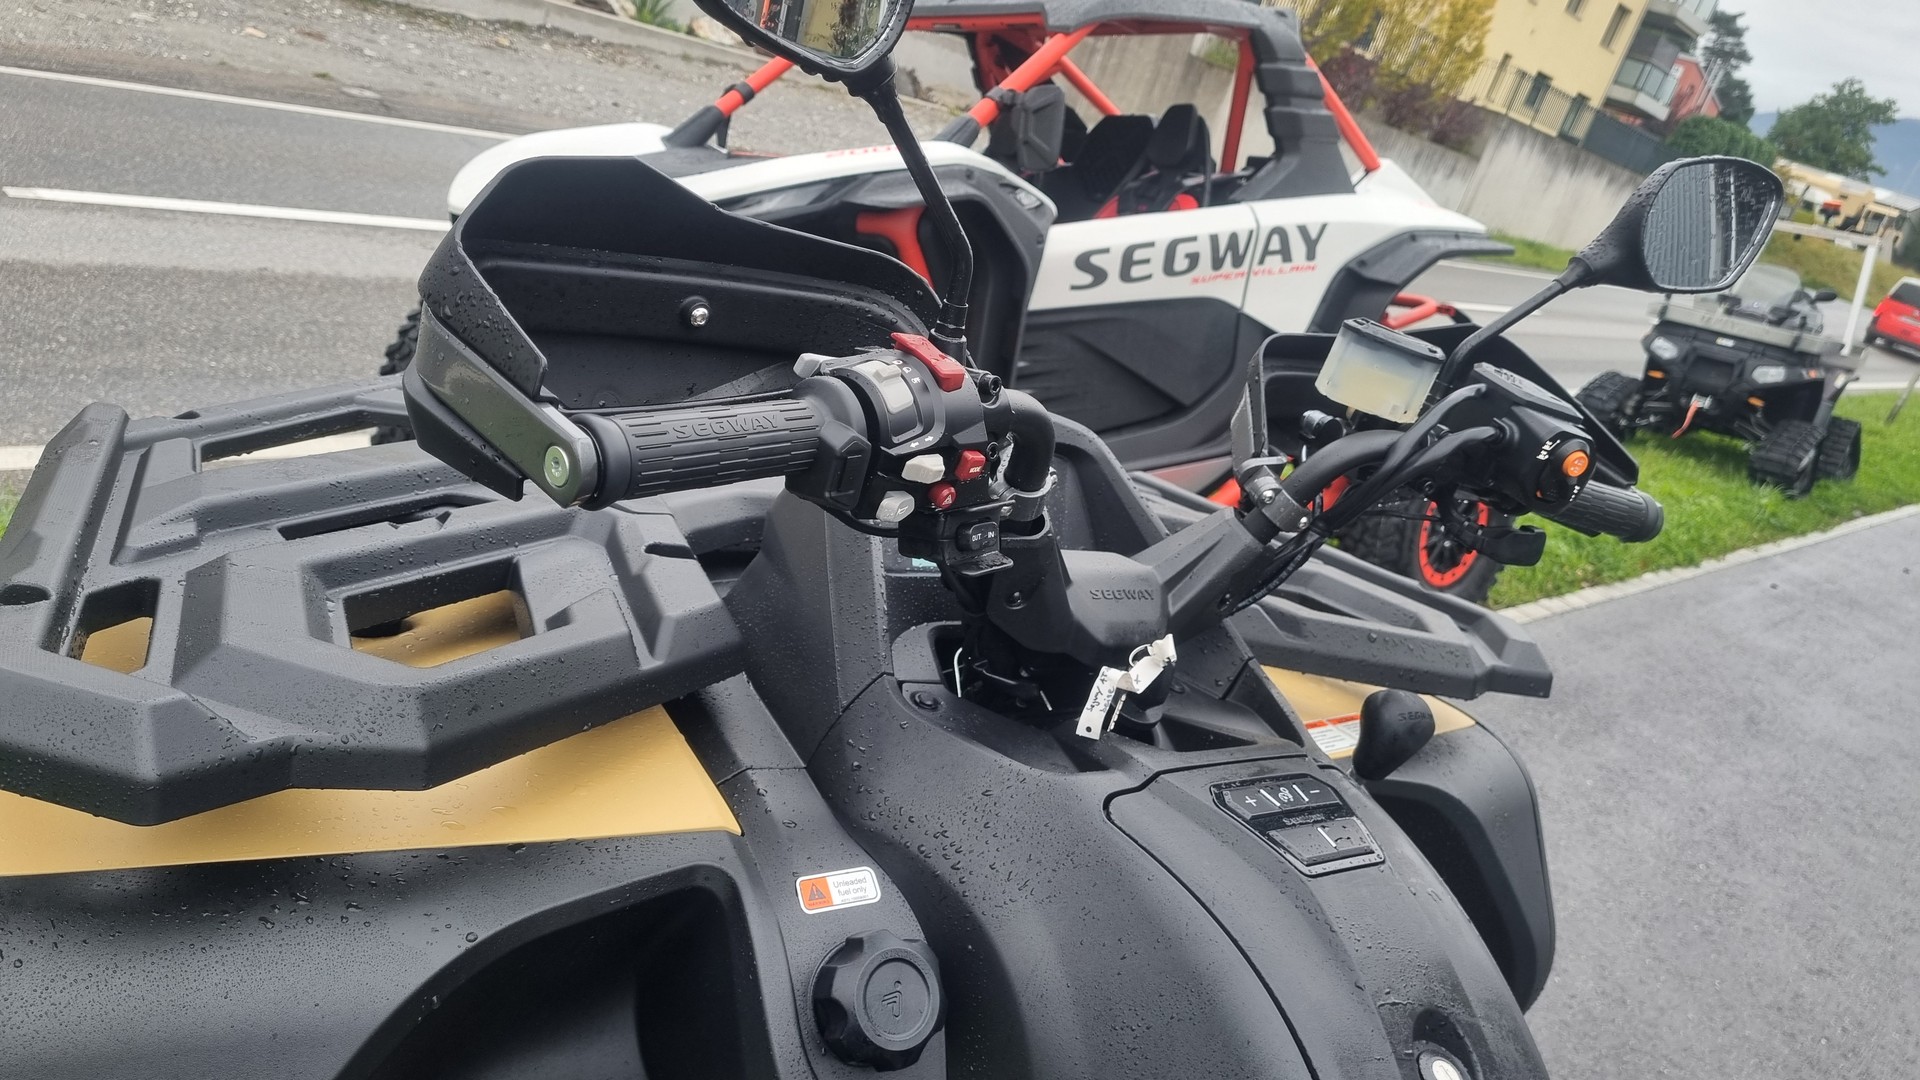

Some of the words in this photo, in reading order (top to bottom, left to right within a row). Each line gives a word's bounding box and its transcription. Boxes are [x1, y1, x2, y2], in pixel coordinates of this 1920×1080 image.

[1070, 223, 1328, 290] SEGWAY
[1190, 270, 1246, 285] SUPER
[1250, 264, 1317, 277] VILLAIN
[673, 415, 778, 439] SEGWAY
[971, 533, 982, 542] OUT
[1089, 589, 1154, 601] SEGWAY
[832, 877, 867, 889] Unleaded
[838, 889, 852, 897] fuel
[853, 886, 868, 895] only
